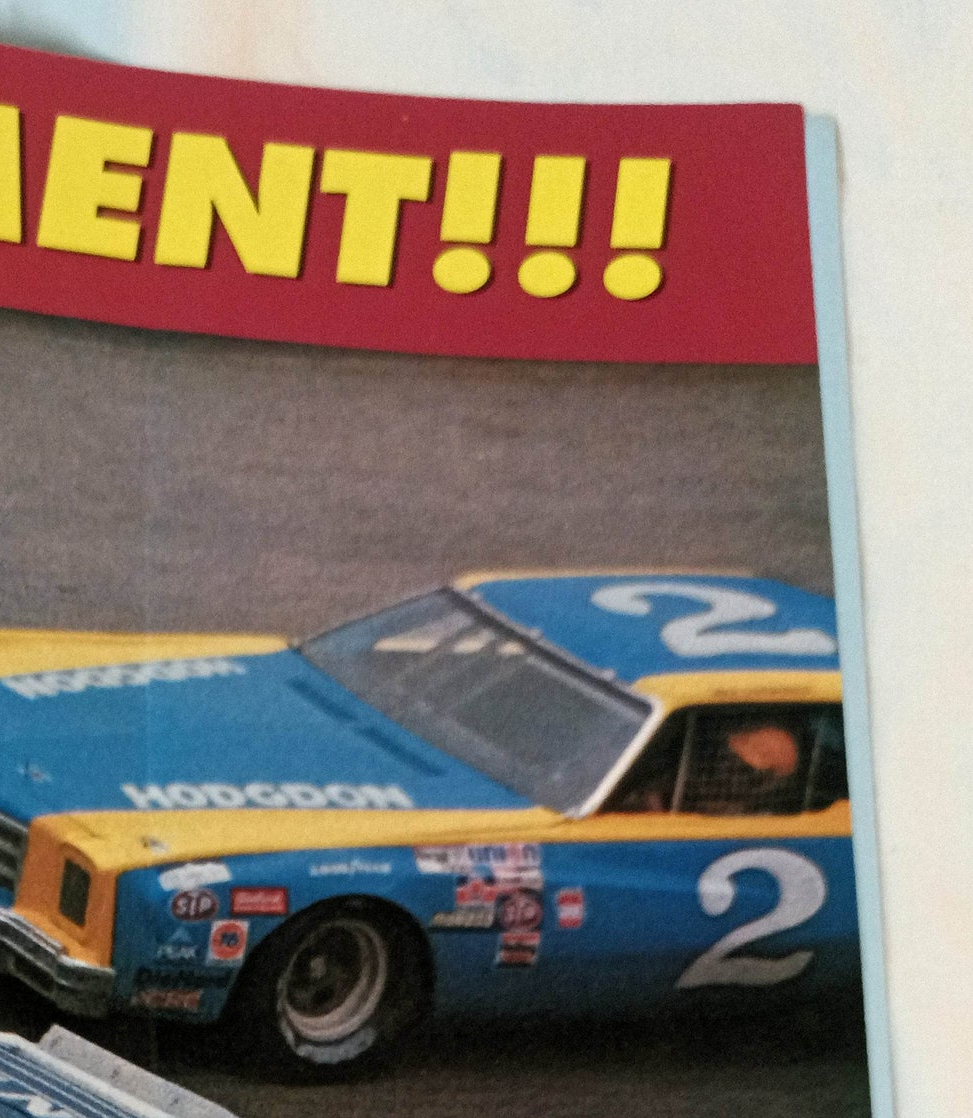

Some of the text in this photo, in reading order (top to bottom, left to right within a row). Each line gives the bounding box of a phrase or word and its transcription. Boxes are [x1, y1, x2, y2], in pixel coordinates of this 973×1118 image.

[591, 581, 838, 657] 2
[120, 782, 416, 810] HODGDON
[674, 847, 827, 989] 2
